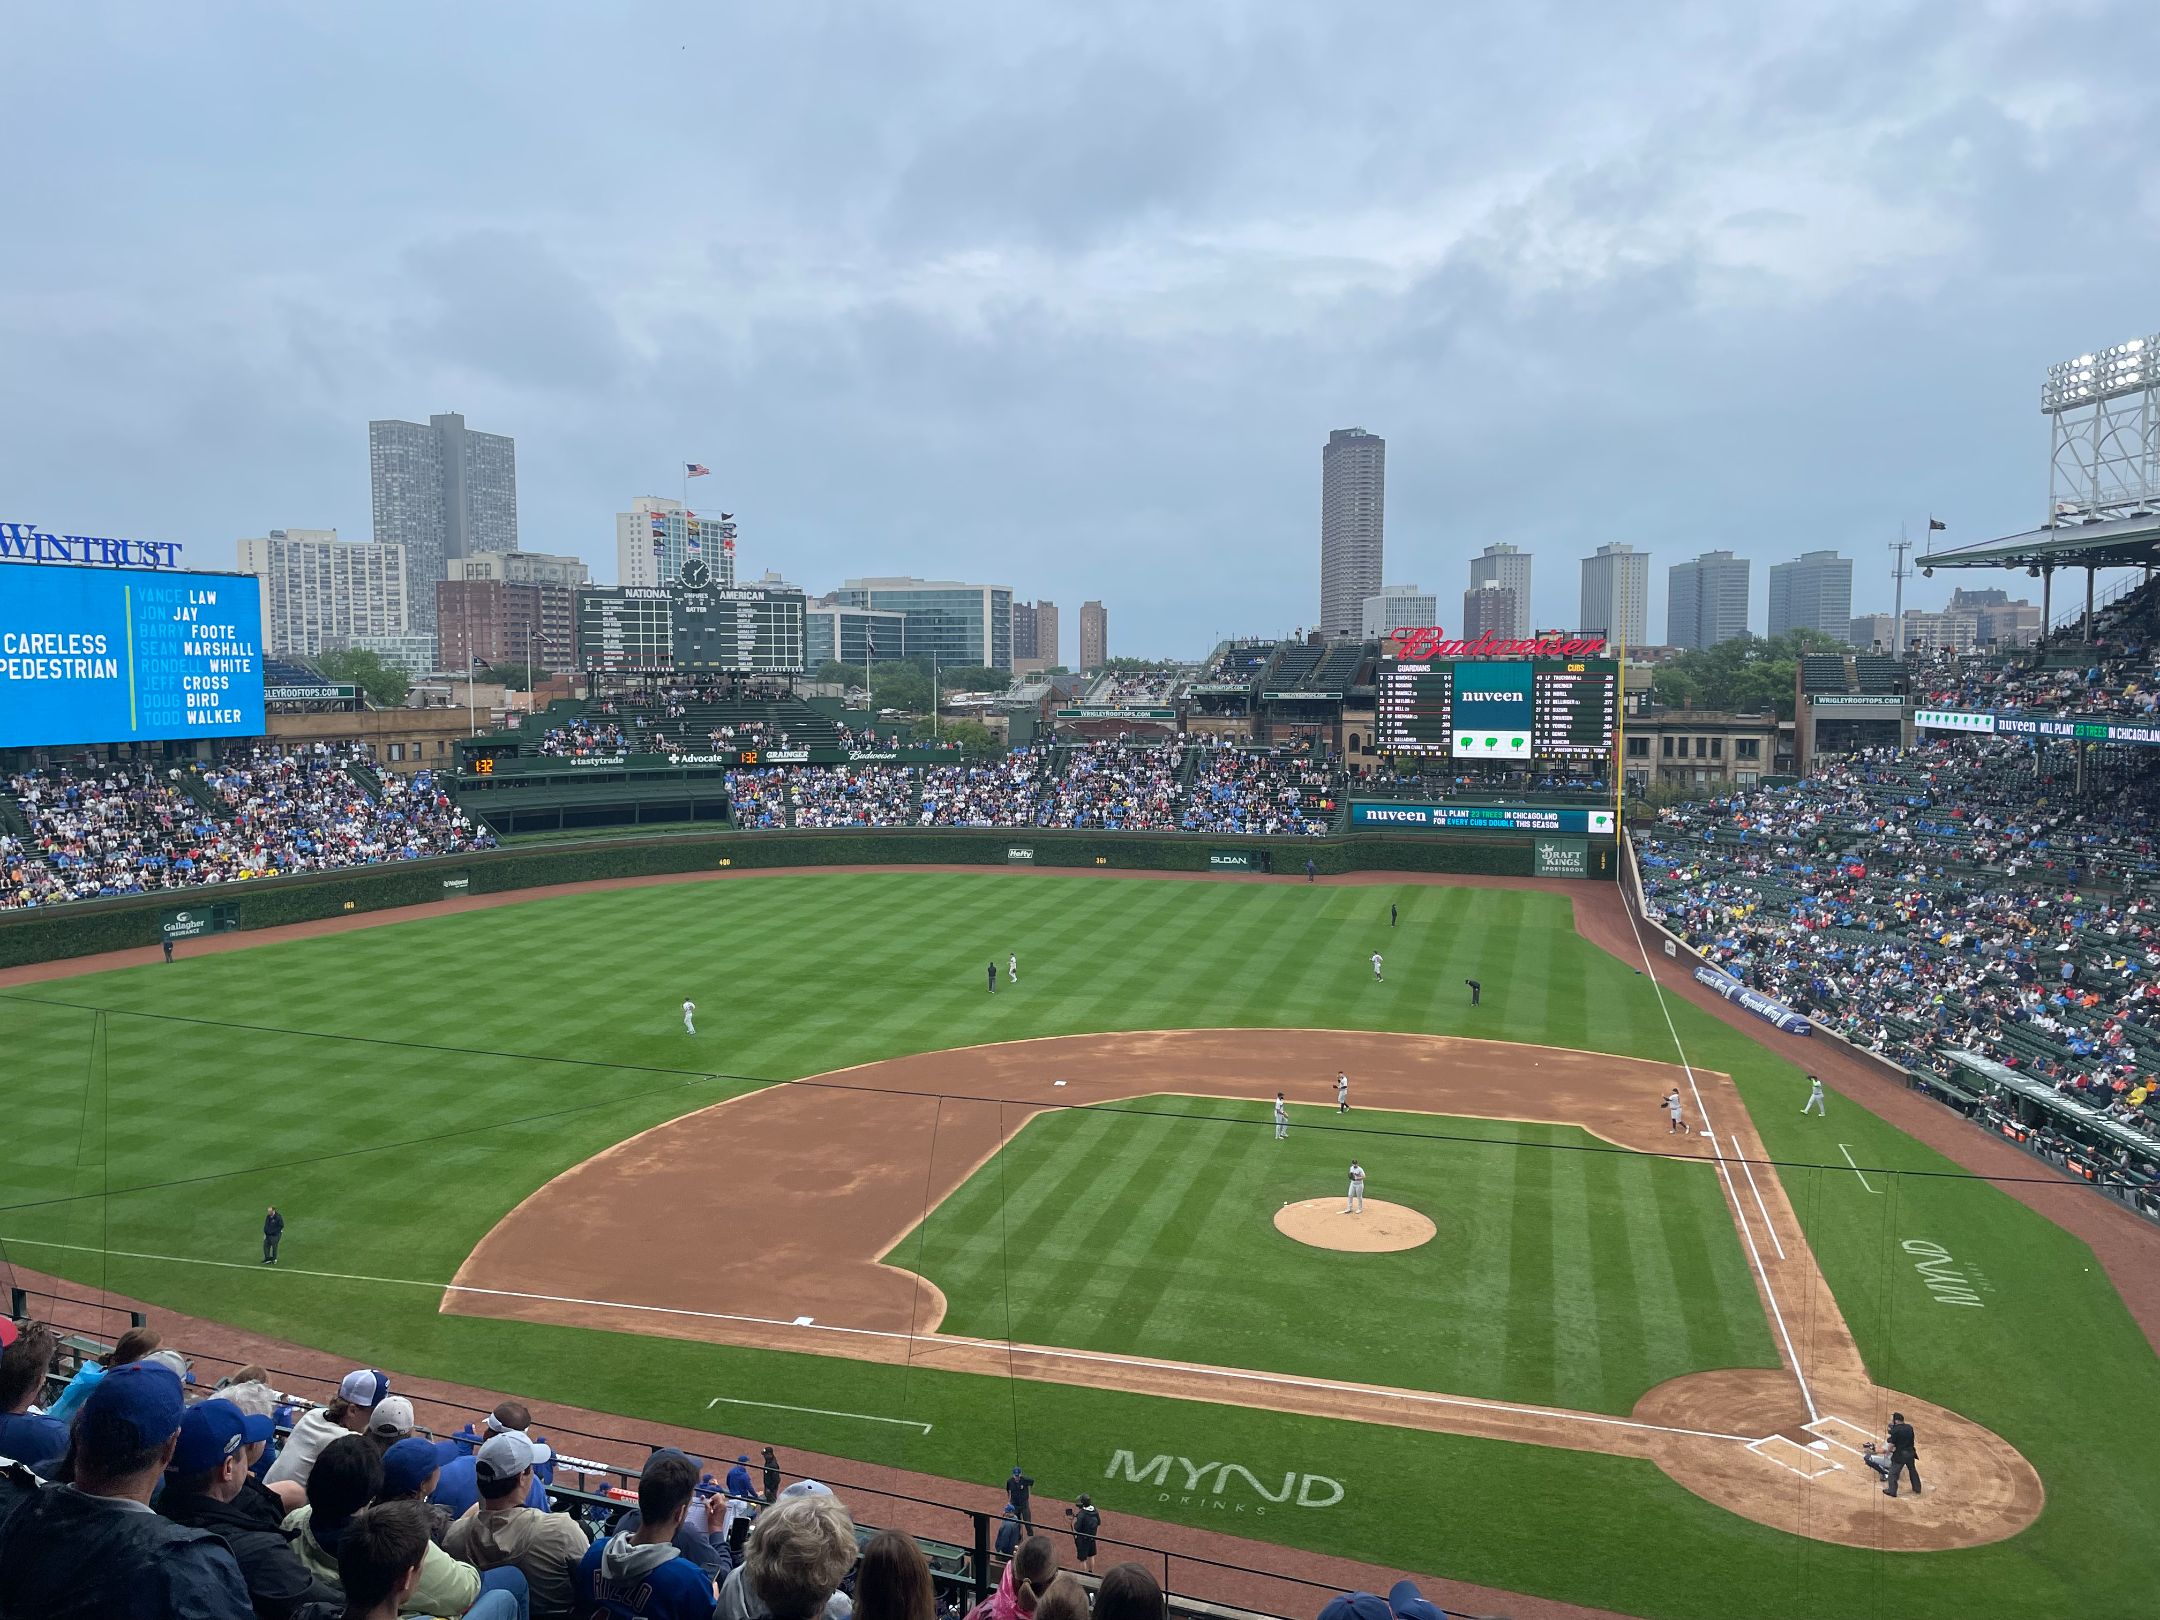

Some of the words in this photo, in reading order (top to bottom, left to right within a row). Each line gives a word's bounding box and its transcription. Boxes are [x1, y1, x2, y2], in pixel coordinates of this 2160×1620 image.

[0, 522, 182, 568] WINTRUST
[138, 588, 183, 603] VANCE
[189, 590, 216, 604] LAW
[625, 589, 672, 598] NATIONAL
[720, 591, 765, 600] AMERICAN
[140, 606, 166, 620] JON
[173, 607, 198, 621] JAY
[140, 624, 185, 638] BARRY
[192, 625, 236, 639] FOOTE
[4, 633, 107, 655] CARELESS
[140, 641, 177, 656] SEAN
[184, 642, 254, 656] MARSHALL
[1390, 626, 1607, 661] Budweiser
[0, 659, 118, 679] PEDESTRIAN
[141, 659, 203, 673] RONDELL
[210, 659, 251, 673] WHITE
[1398, 664, 1430, 672] GUARDIANS
[1568, 664, 1584, 672] CUBS
[143, 676, 176, 690] JEFF
[184, 676, 229, 690] CROSS
[143, 694, 180, 708] DOUG
[186, 693, 219, 708] BIRD
[1462, 690, 1524, 702] nuveen
[144, 711, 180, 726] TODD
[187, 710, 242, 724] WALKER
[1998, 720, 2036, 732] nuveen
[2040, 722, 2054, 734] WILL
[2055, 724, 2074, 736] PLANT
[2076, 725, 2084, 736] 23
[2086, 726, 2107, 738] TREES
[2108, 726, 2116, 738] IN
[577, 756, 624, 766] tastytrade
[681, 754, 722, 762] Advocate
[848, 750, 897, 760] Budweiser
[1366, 810, 1426, 822] nuveen
[1448, 810, 1470, 818] PLANT
[1472, 810, 1480, 818] 23
[1512, 812, 1558, 820] CHICAGOLAND
[1447, 818, 1468, 826] EVERY
[1488, 820, 1514, 828] DOUBLE
[1516, 820, 1530, 828] THIS
[1010, 850, 1032, 858] Hefty
[1210, 856, 1247, 864] SLOAN
[1542, 852, 1582, 860] DRAFT
[1546, 858, 1580, 866] KINGS
[164, 920, 204, 932] Gallagher
[170, 928, 200, 937] INSURANCE
[1739, 992, 1767, 1013] Reynolds
[1762, 1006, 1782, 1023] Wrap
[1103, 1448, 1345, 1508] MYND
[620, 1496, 638, 1504] GATO
[1159, 1492, 1266, 1516] DRINKS
